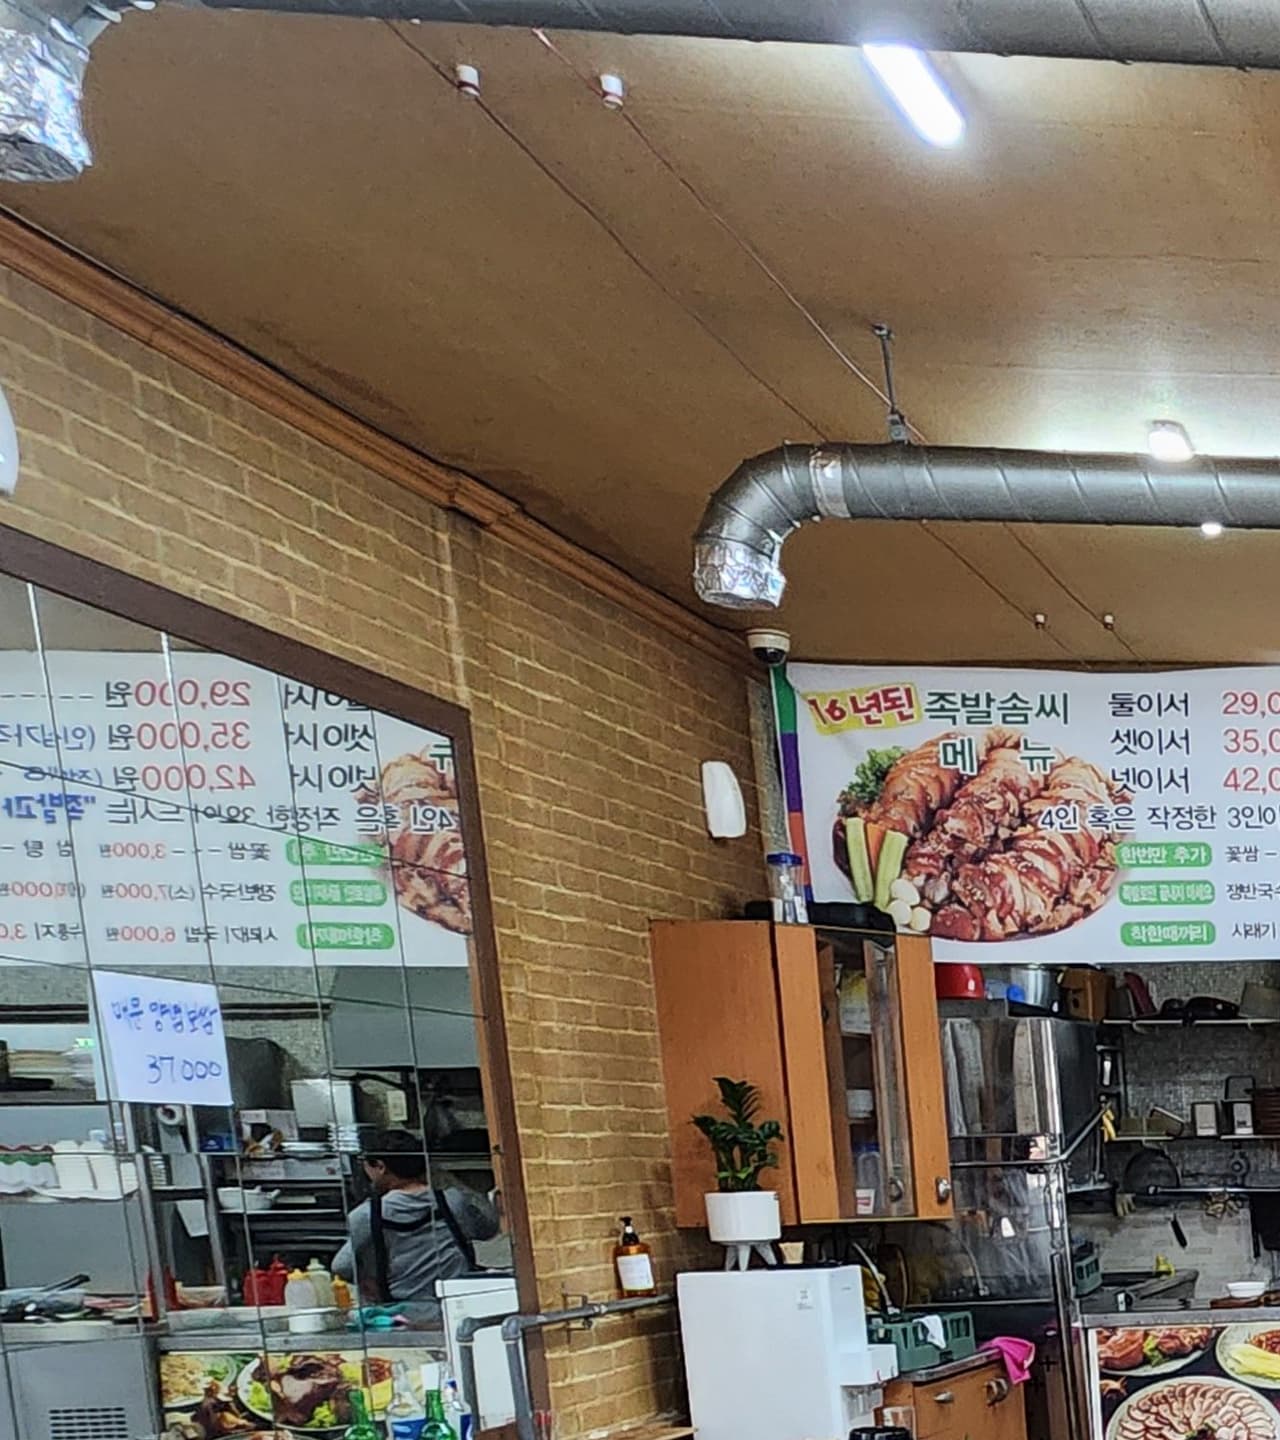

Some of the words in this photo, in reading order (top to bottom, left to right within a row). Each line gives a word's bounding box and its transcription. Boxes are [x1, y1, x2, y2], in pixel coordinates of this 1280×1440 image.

[924, 692, 1069, 725] 족발솜씨
[1108, 692, 1189, 717] 둘이서
[1110, 728, 1190, 755] 셋이서
[1110, 767, 1189, 794] 넷이서
[1040, 805, 1077, 831] 4인
[1088, 804, 1135, 831] 혹은
[1147, 805, 1217, 831] 작정한
[1225, 846, 1258, 863] 꽃쌈
[1232, 922, 1276, 939] 시래기
